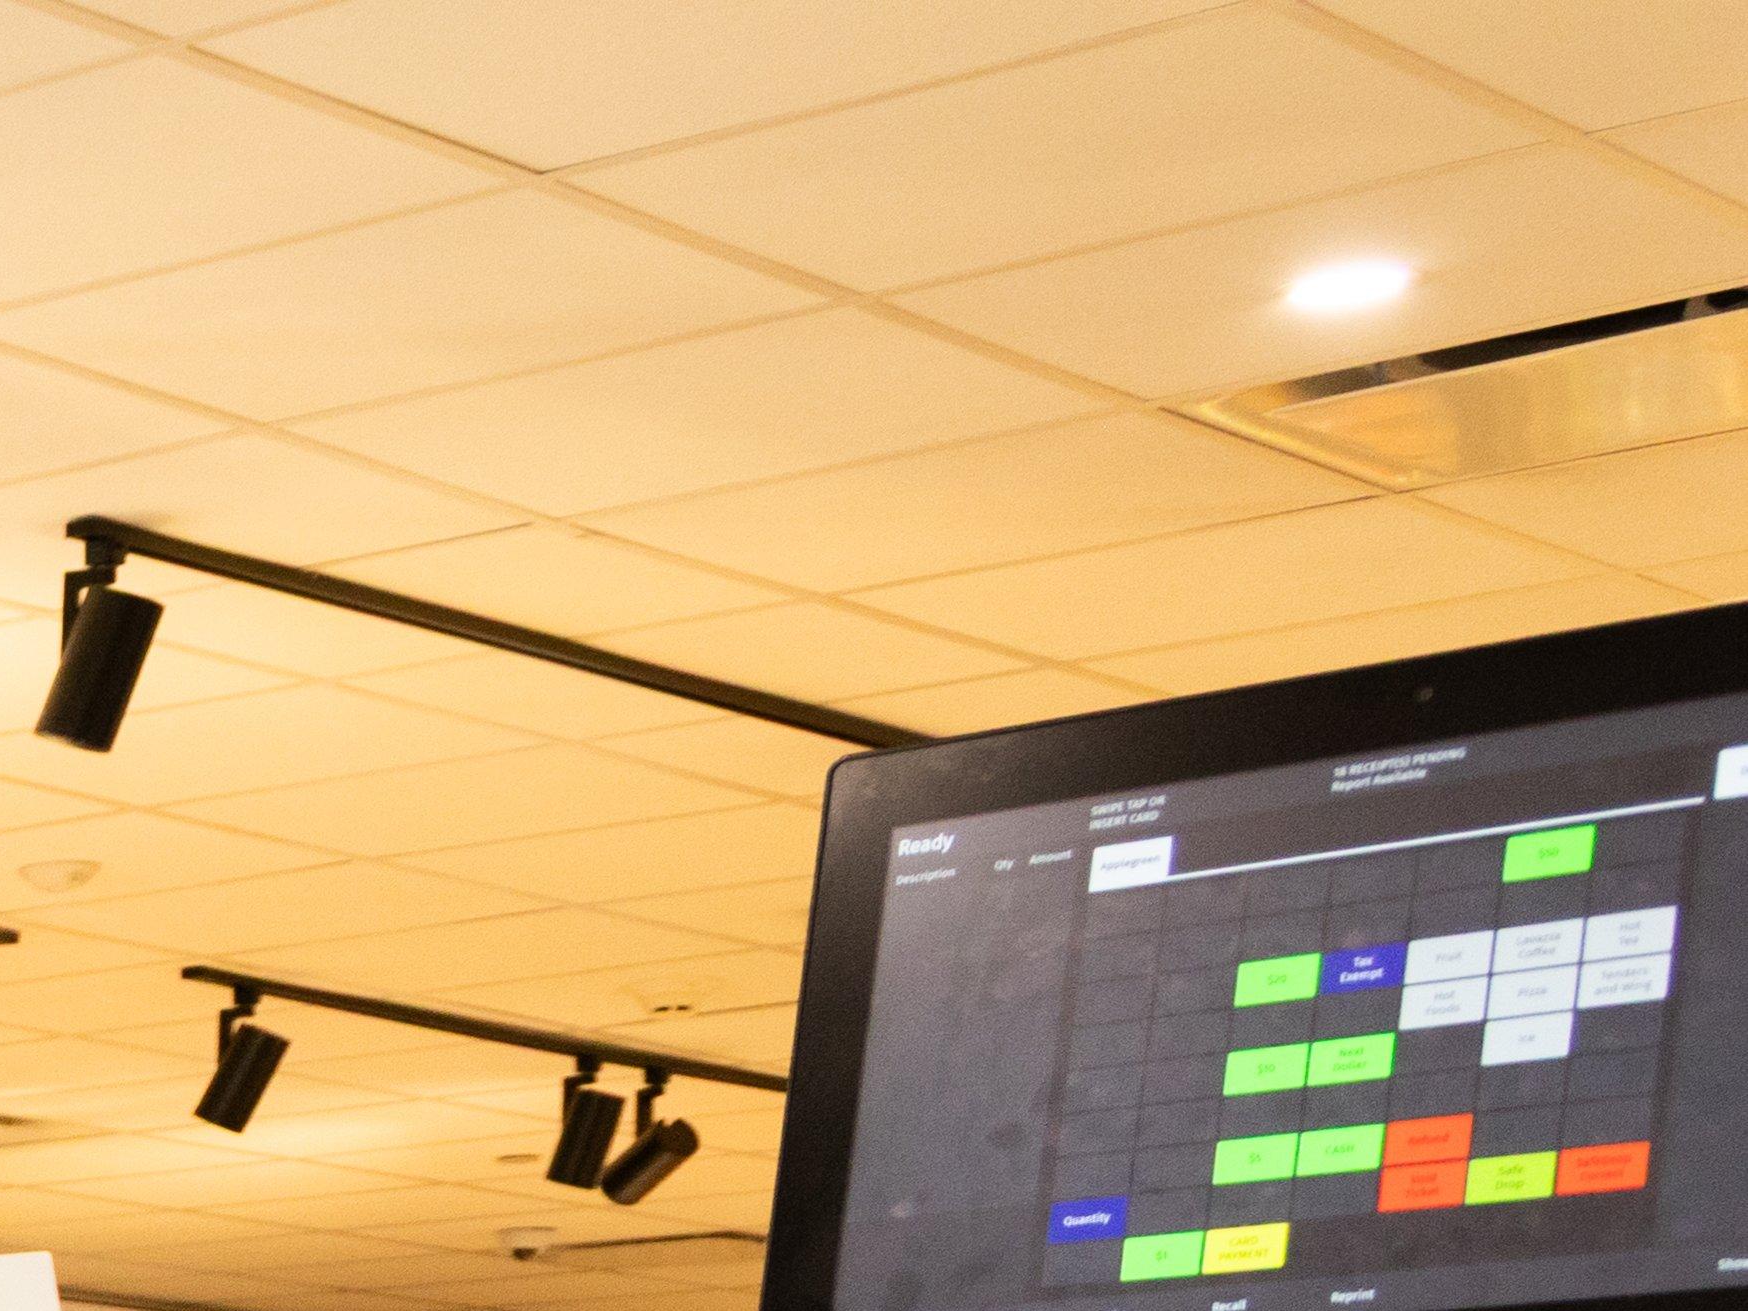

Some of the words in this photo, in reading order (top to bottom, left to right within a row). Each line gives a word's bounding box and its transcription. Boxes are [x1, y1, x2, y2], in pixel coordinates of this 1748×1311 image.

[898, 832, 955, 857] Ready
[895, 867, 956, 887] Description
[994, 858, 1014, 872] Qty
[1029, 849, 1072, 866] Amount
[1339, 967, 1384, 986] Exempt
[1063, 1211, 1112, 1228] Quantity
[1228, 1233, 1260, 1248] CARD
[1218, 1247, 1271, 1264] PAYMENT
[1329, 1287, 1376, 1307] Reprint
